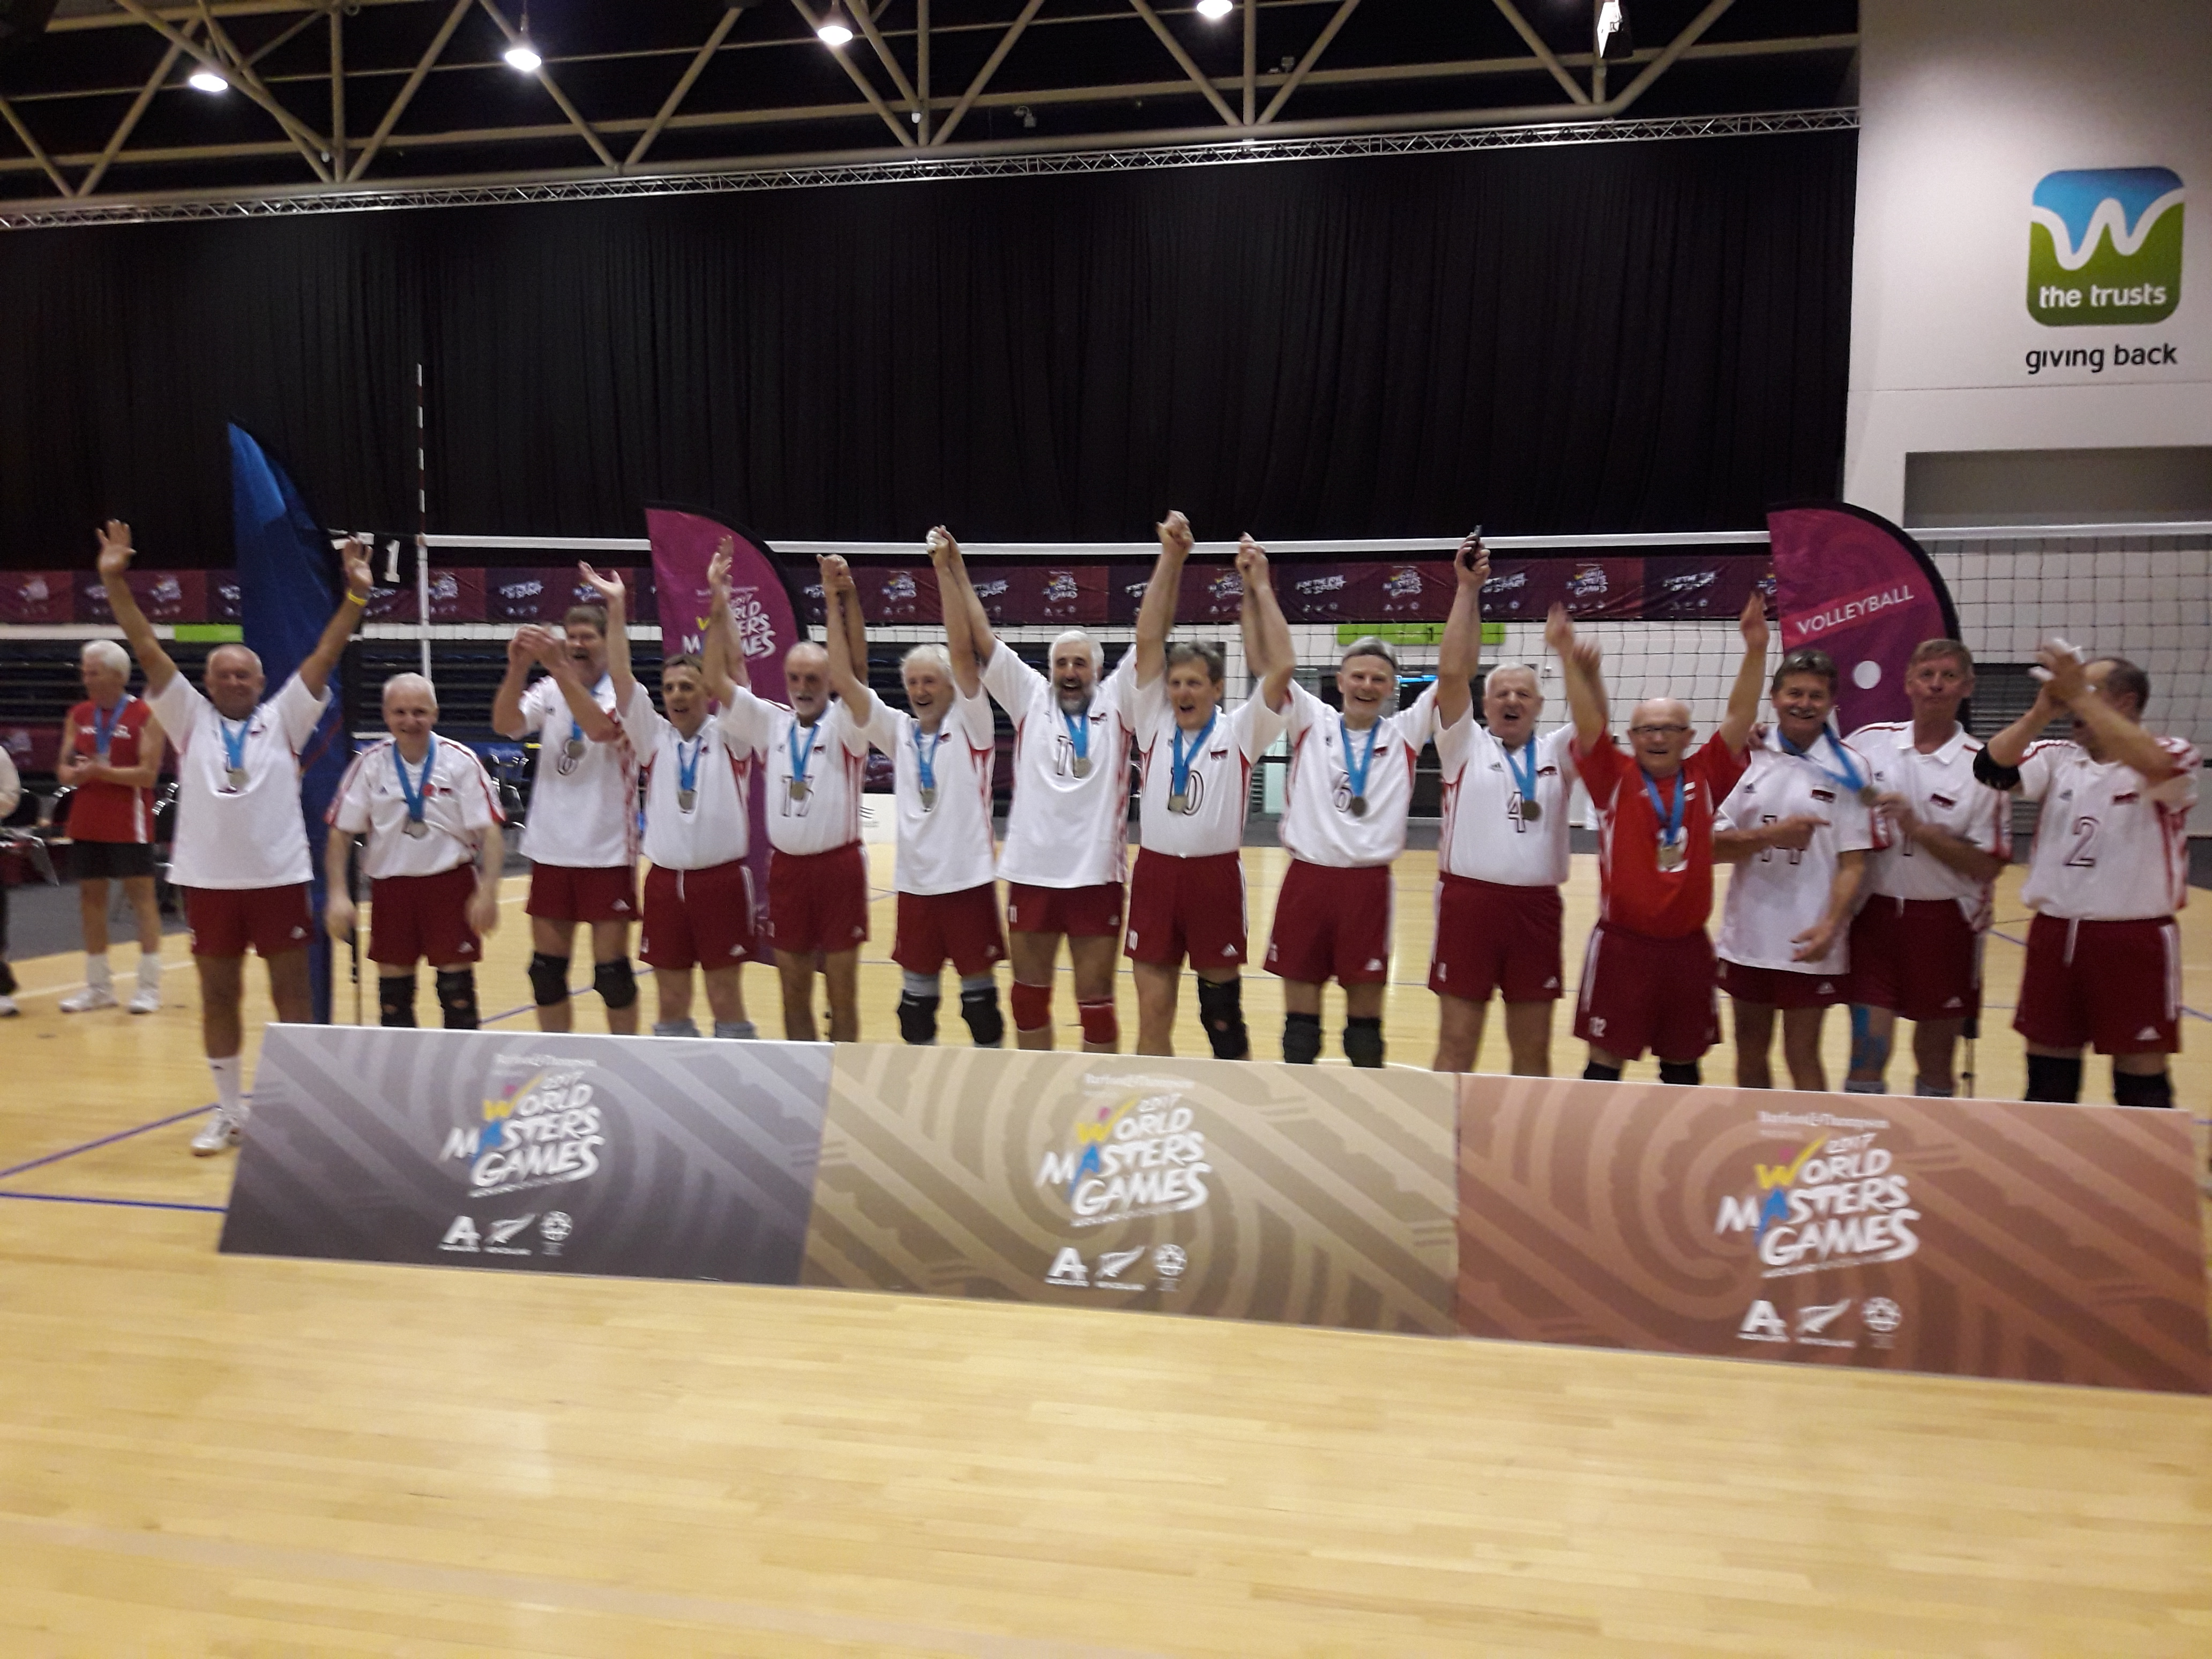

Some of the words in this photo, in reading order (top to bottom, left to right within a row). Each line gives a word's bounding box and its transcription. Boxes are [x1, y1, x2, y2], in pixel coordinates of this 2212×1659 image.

[2039, 286, 2083, 308] the
[2090, 283, 2167, 306] trusts
[2026, 349, 2104, 375] giving
[2114, 343, 2178, 365] back
[1796, 585, 1915, 635] VOLLEYBALL
[1333, 772, 1352, 812] 6
[1507, 791, 1527, 833] 4
[2063, 816, 2099, 866] 2
[484, 1074, 593, 1120] WORLD
[1076, 1095, 1194, 1144] WORLD
[439, 1106, 602, 1164] MASTERS
[470, 1134, 606, 1187] GAMES
[1034, 1131, 1206, 1191] MASTERS
[1754, 1135, 1893, 1189] WORLD
[1072, 1161, 1212, 1216] GAMES
[1715, 1174, 1911, 1237] MASTERS
[1759, 1208, 1922, 1266] GAMES
